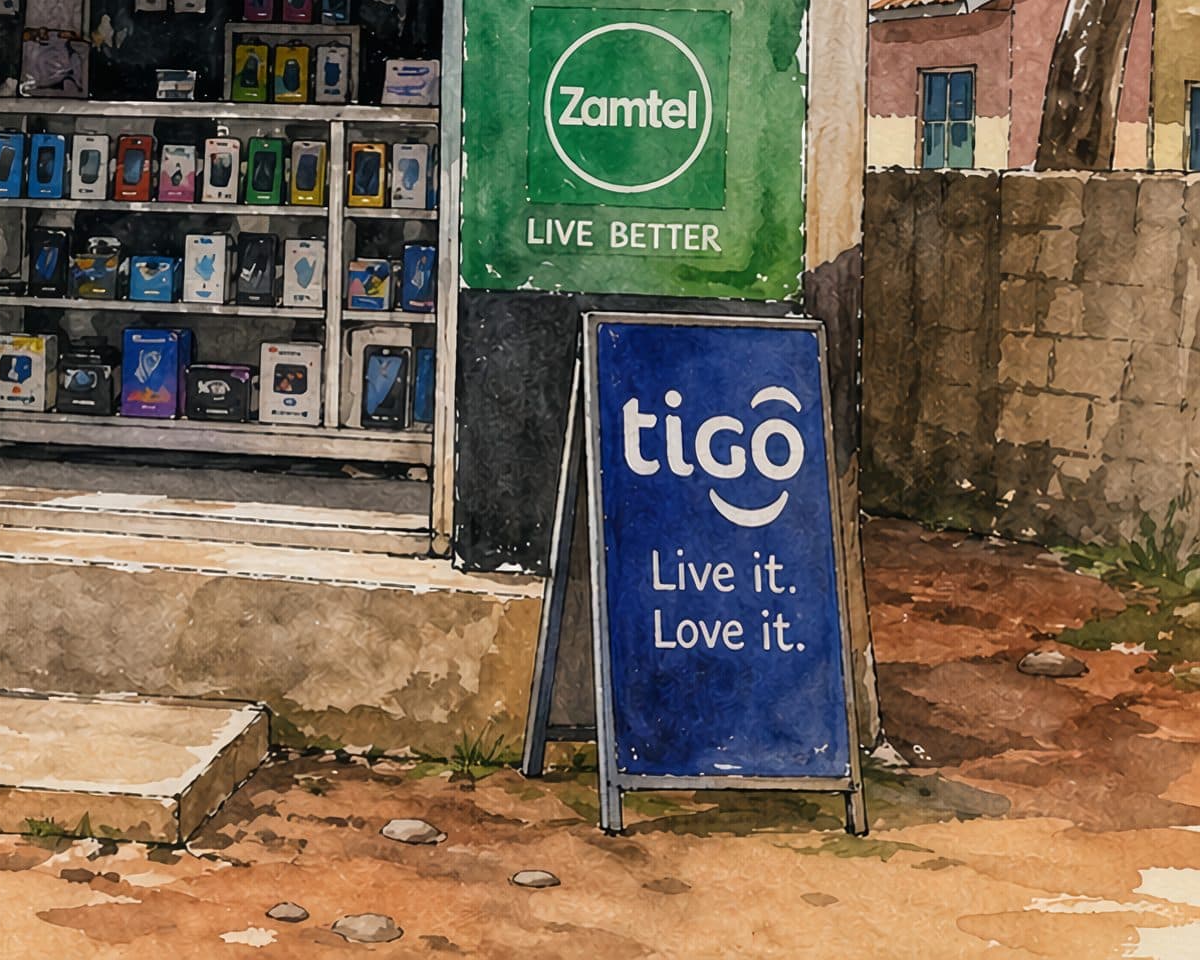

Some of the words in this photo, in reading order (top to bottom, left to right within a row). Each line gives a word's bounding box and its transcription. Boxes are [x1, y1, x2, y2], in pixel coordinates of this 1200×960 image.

[559, 86, 698, 129] Zamtel
[527, 218, 593, 247] LIVE
[610, 222, 722, 252] BETTER
[652, 549, 735, 592] Live
[754, 551, 796, 594] it.
[654, 609, 744, 651] Love
[762, 609, 805, 652] it.
